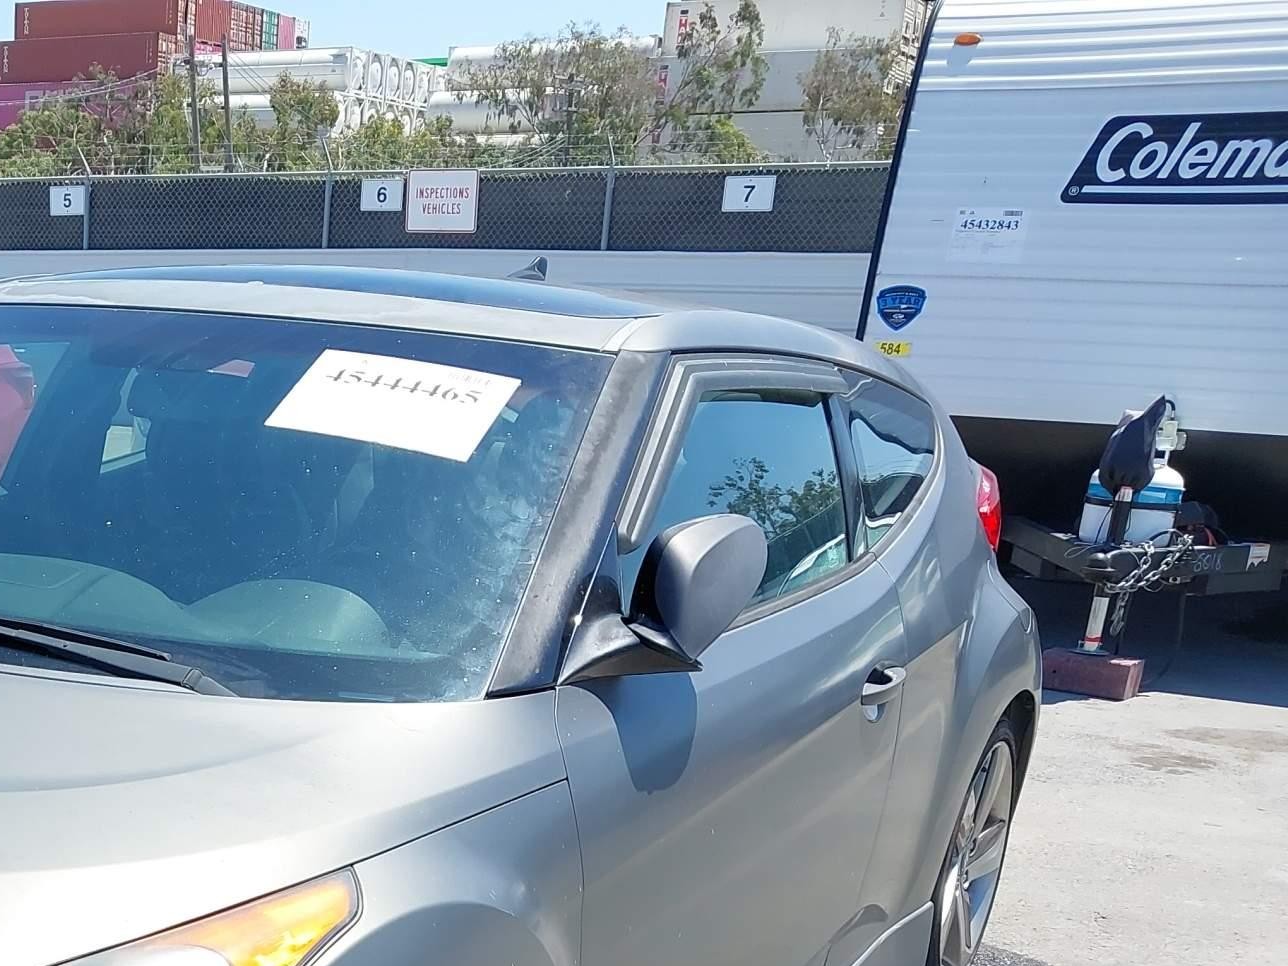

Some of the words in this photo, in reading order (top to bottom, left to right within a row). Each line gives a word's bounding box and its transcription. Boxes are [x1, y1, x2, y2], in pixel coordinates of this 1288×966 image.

[376, 186, 388, 203] 6
[415, 187, 470, 199] INSPECTIONS
[743, 185, 756, 203] 7
[63, 193, 72, 208] 5
[422, 203, 461, 214] VEHICLES
[960, 219, 1019, 230] 45432843
[880, 342, 901, 355] 584
[325, 368, 483, 404] 45444465
